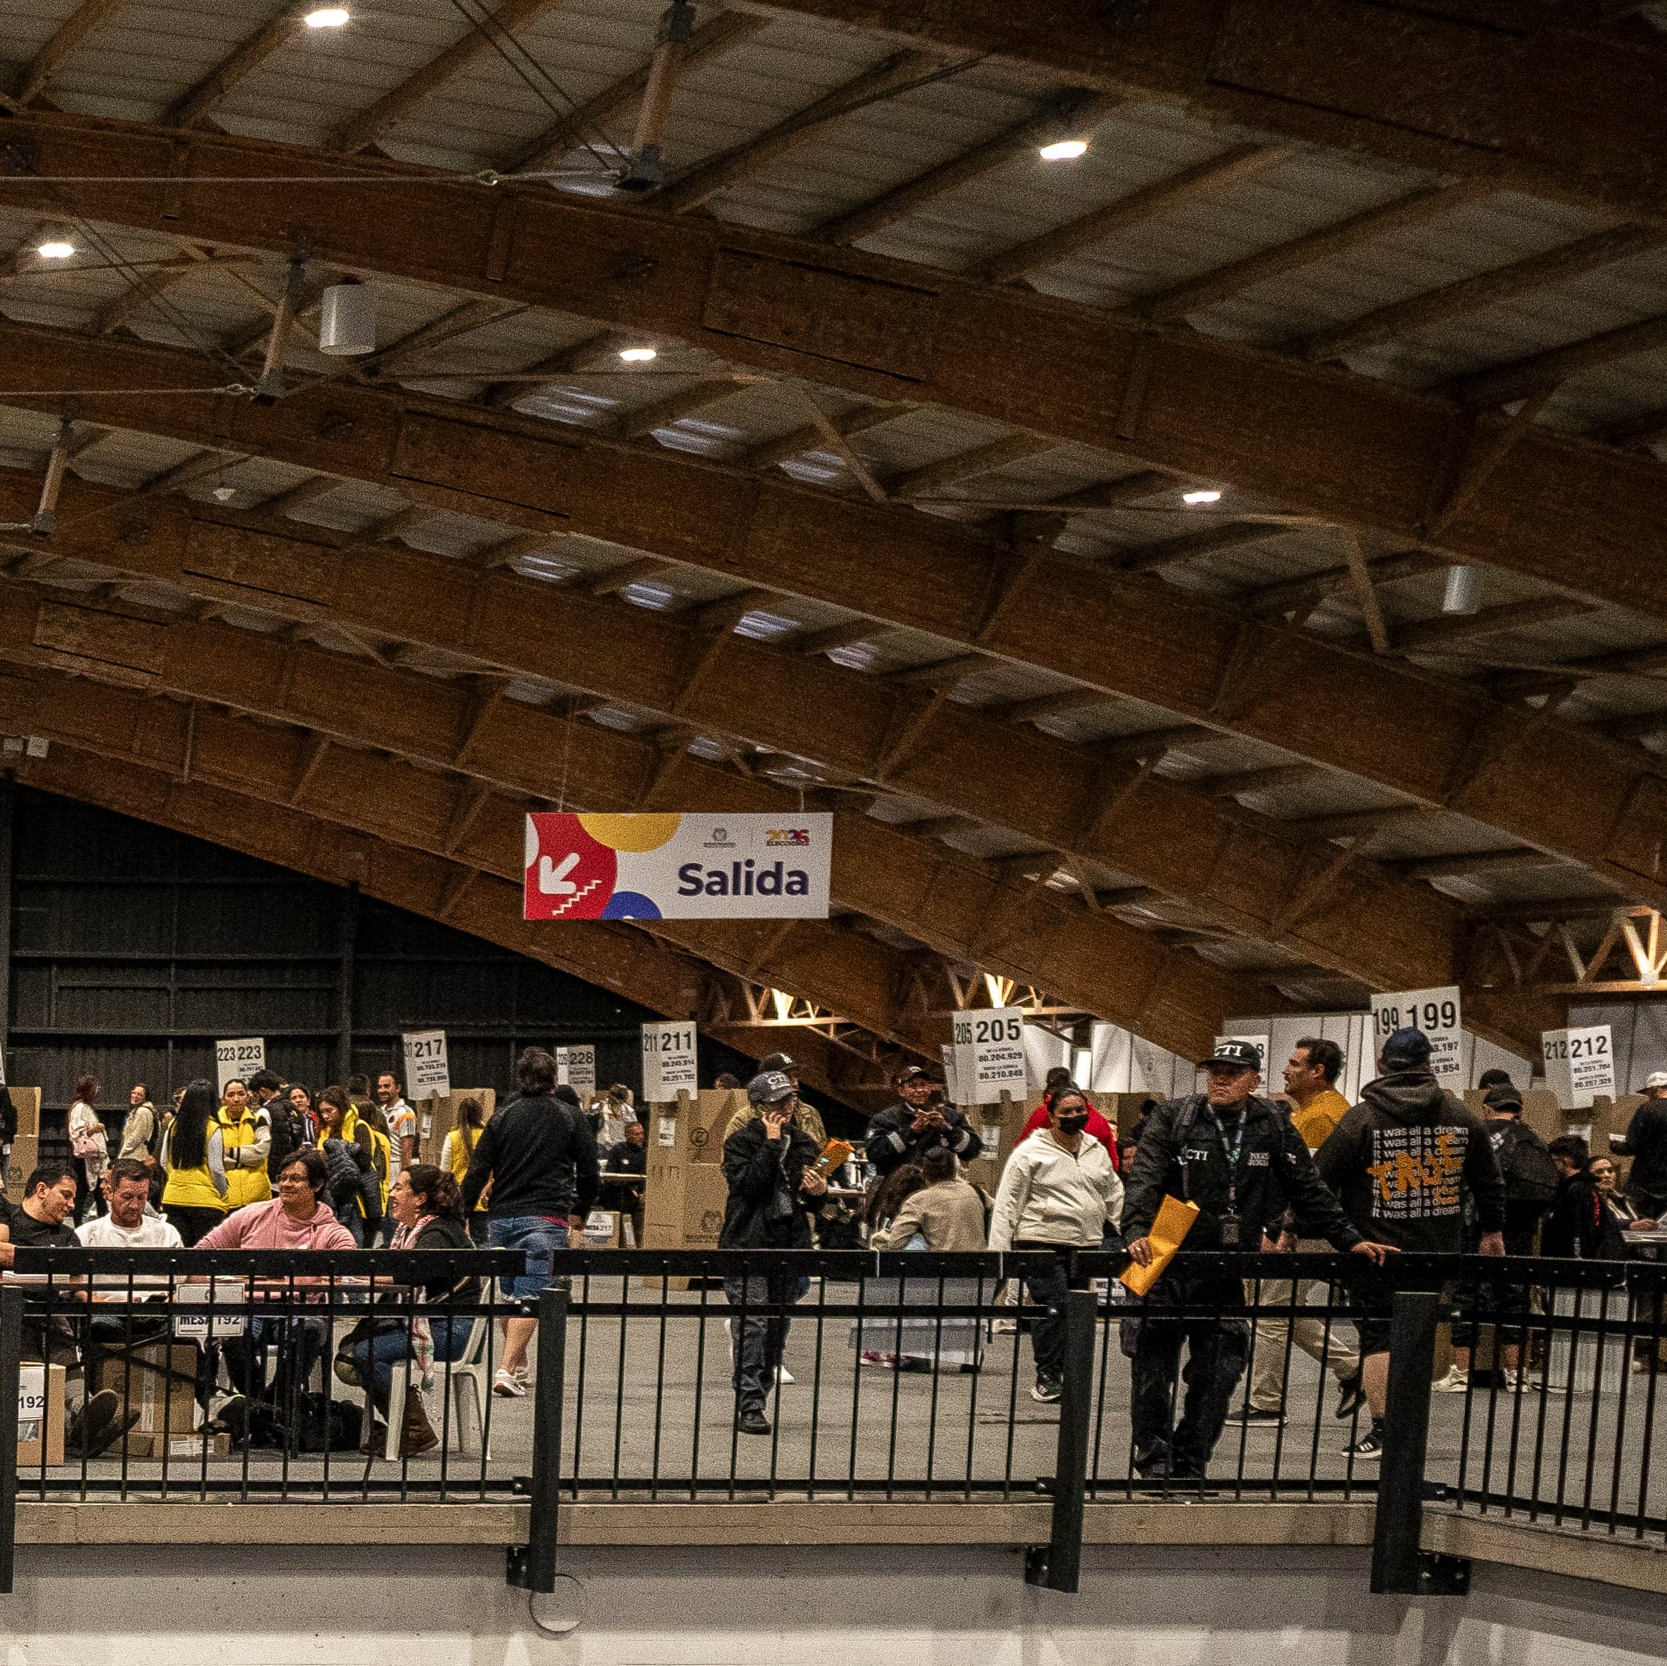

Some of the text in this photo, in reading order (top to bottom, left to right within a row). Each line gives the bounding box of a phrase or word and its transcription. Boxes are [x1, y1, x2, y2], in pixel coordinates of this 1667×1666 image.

[676, 860, 811, 900] Salida
[1372, 1007, 1399, 1036] 199
[1405, 1001, 1457, 1031] 199
[661, 1030, 692, 1051] 211
[955, 1022, 973, 1046] 205
[976, 1019, 1021, 1043] 205
[217, 1046, 236, 1062] 223
[238, 1045, 262, 1061] 223
[414, 1039, 444, 1059] 217
[1544, 1040, 1568, 1061] 212
[1571, 1036, 1609, 1059] 212
[569, 1051, 594, 1066] 228
[1384, 1128, 1408, 1137] was
[1409, 1125, 1421, 1135] all
[1434, 1125, 1468, 1136] dream
[1186, 1149, 1209, 1161] CTI
[1384, 1210, 1407, 1219] was
[1409, 1208, 1422, 1218] all
[1432, 1206, 1461, 1217] dream
